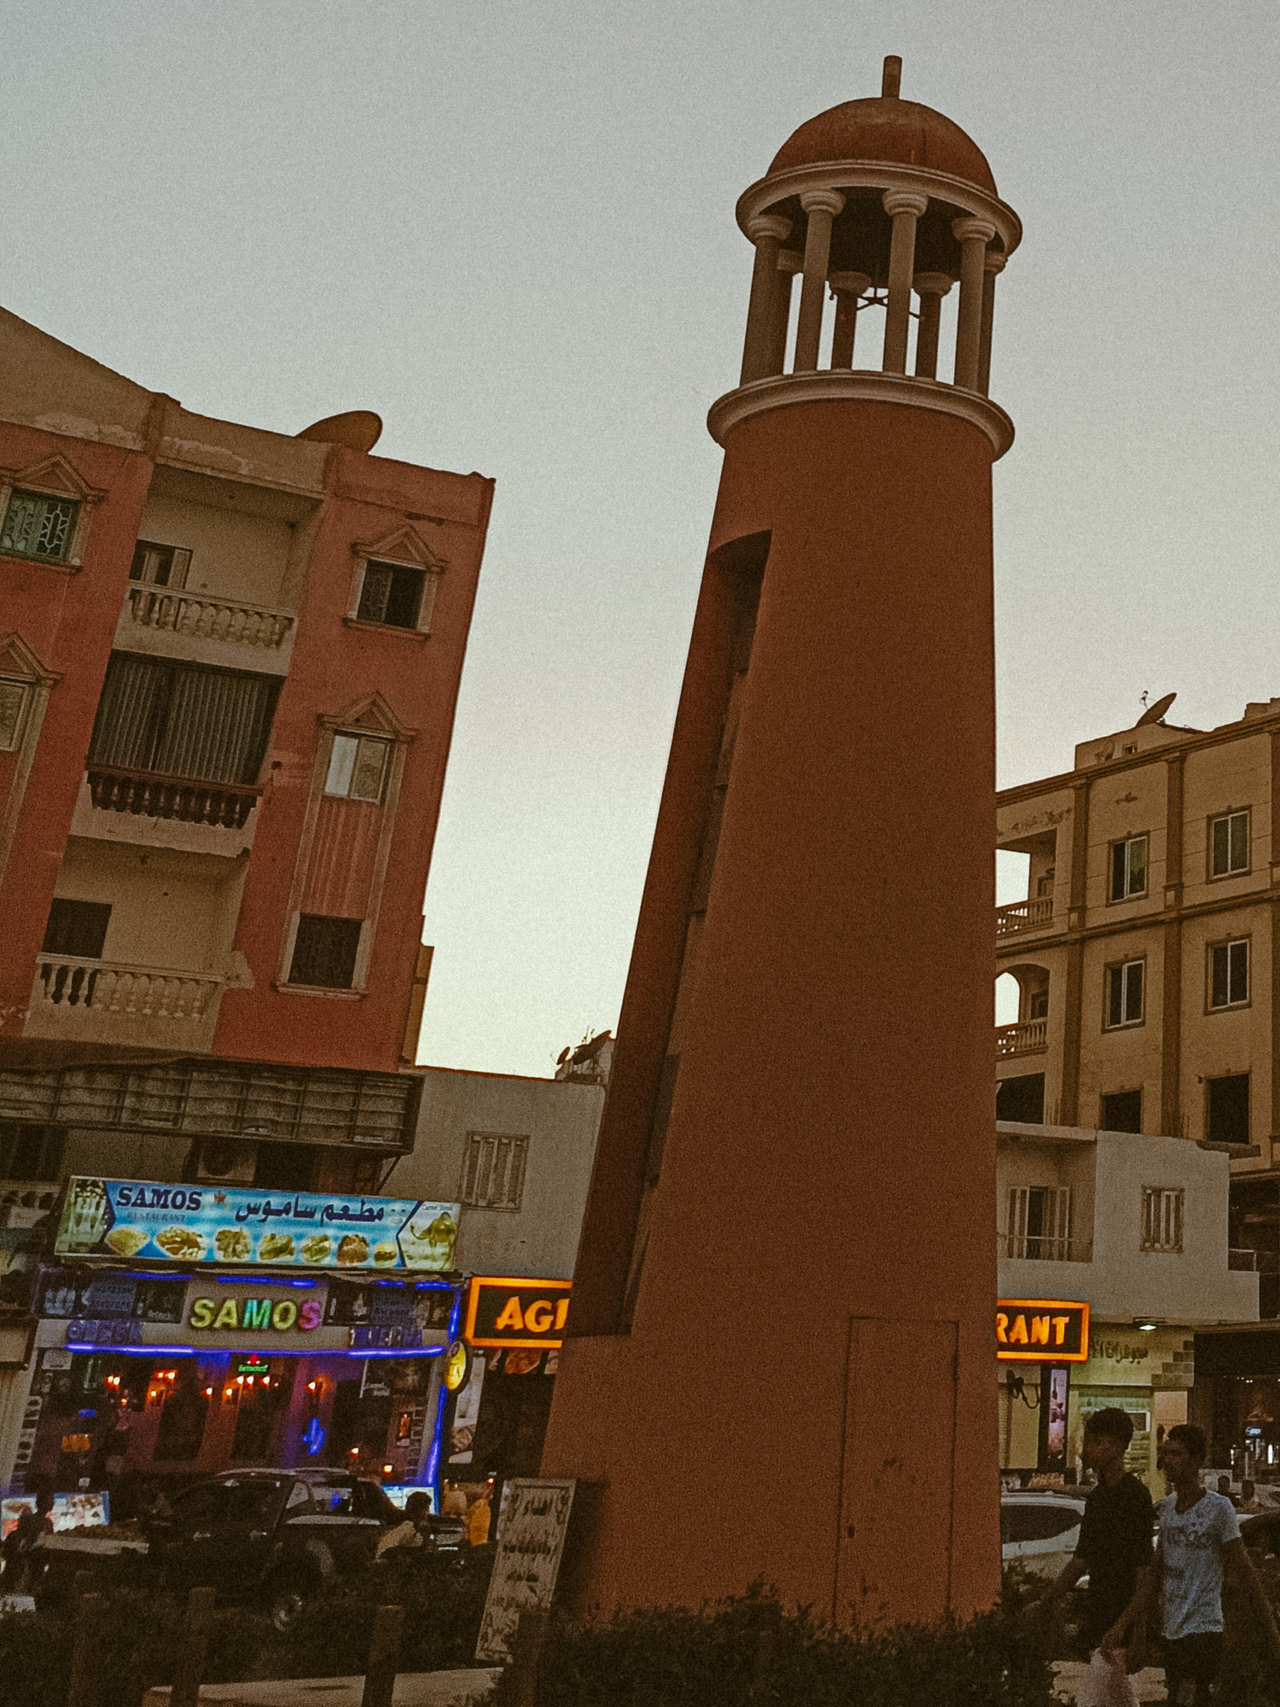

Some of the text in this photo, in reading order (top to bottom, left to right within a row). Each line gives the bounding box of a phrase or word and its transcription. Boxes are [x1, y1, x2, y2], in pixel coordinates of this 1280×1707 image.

[116, 1187, 202, 1211] SAMOS
[235, 1195, 384, 1227] مطعم ساموس
[190, 1298, 321, 1330] SAMOS
